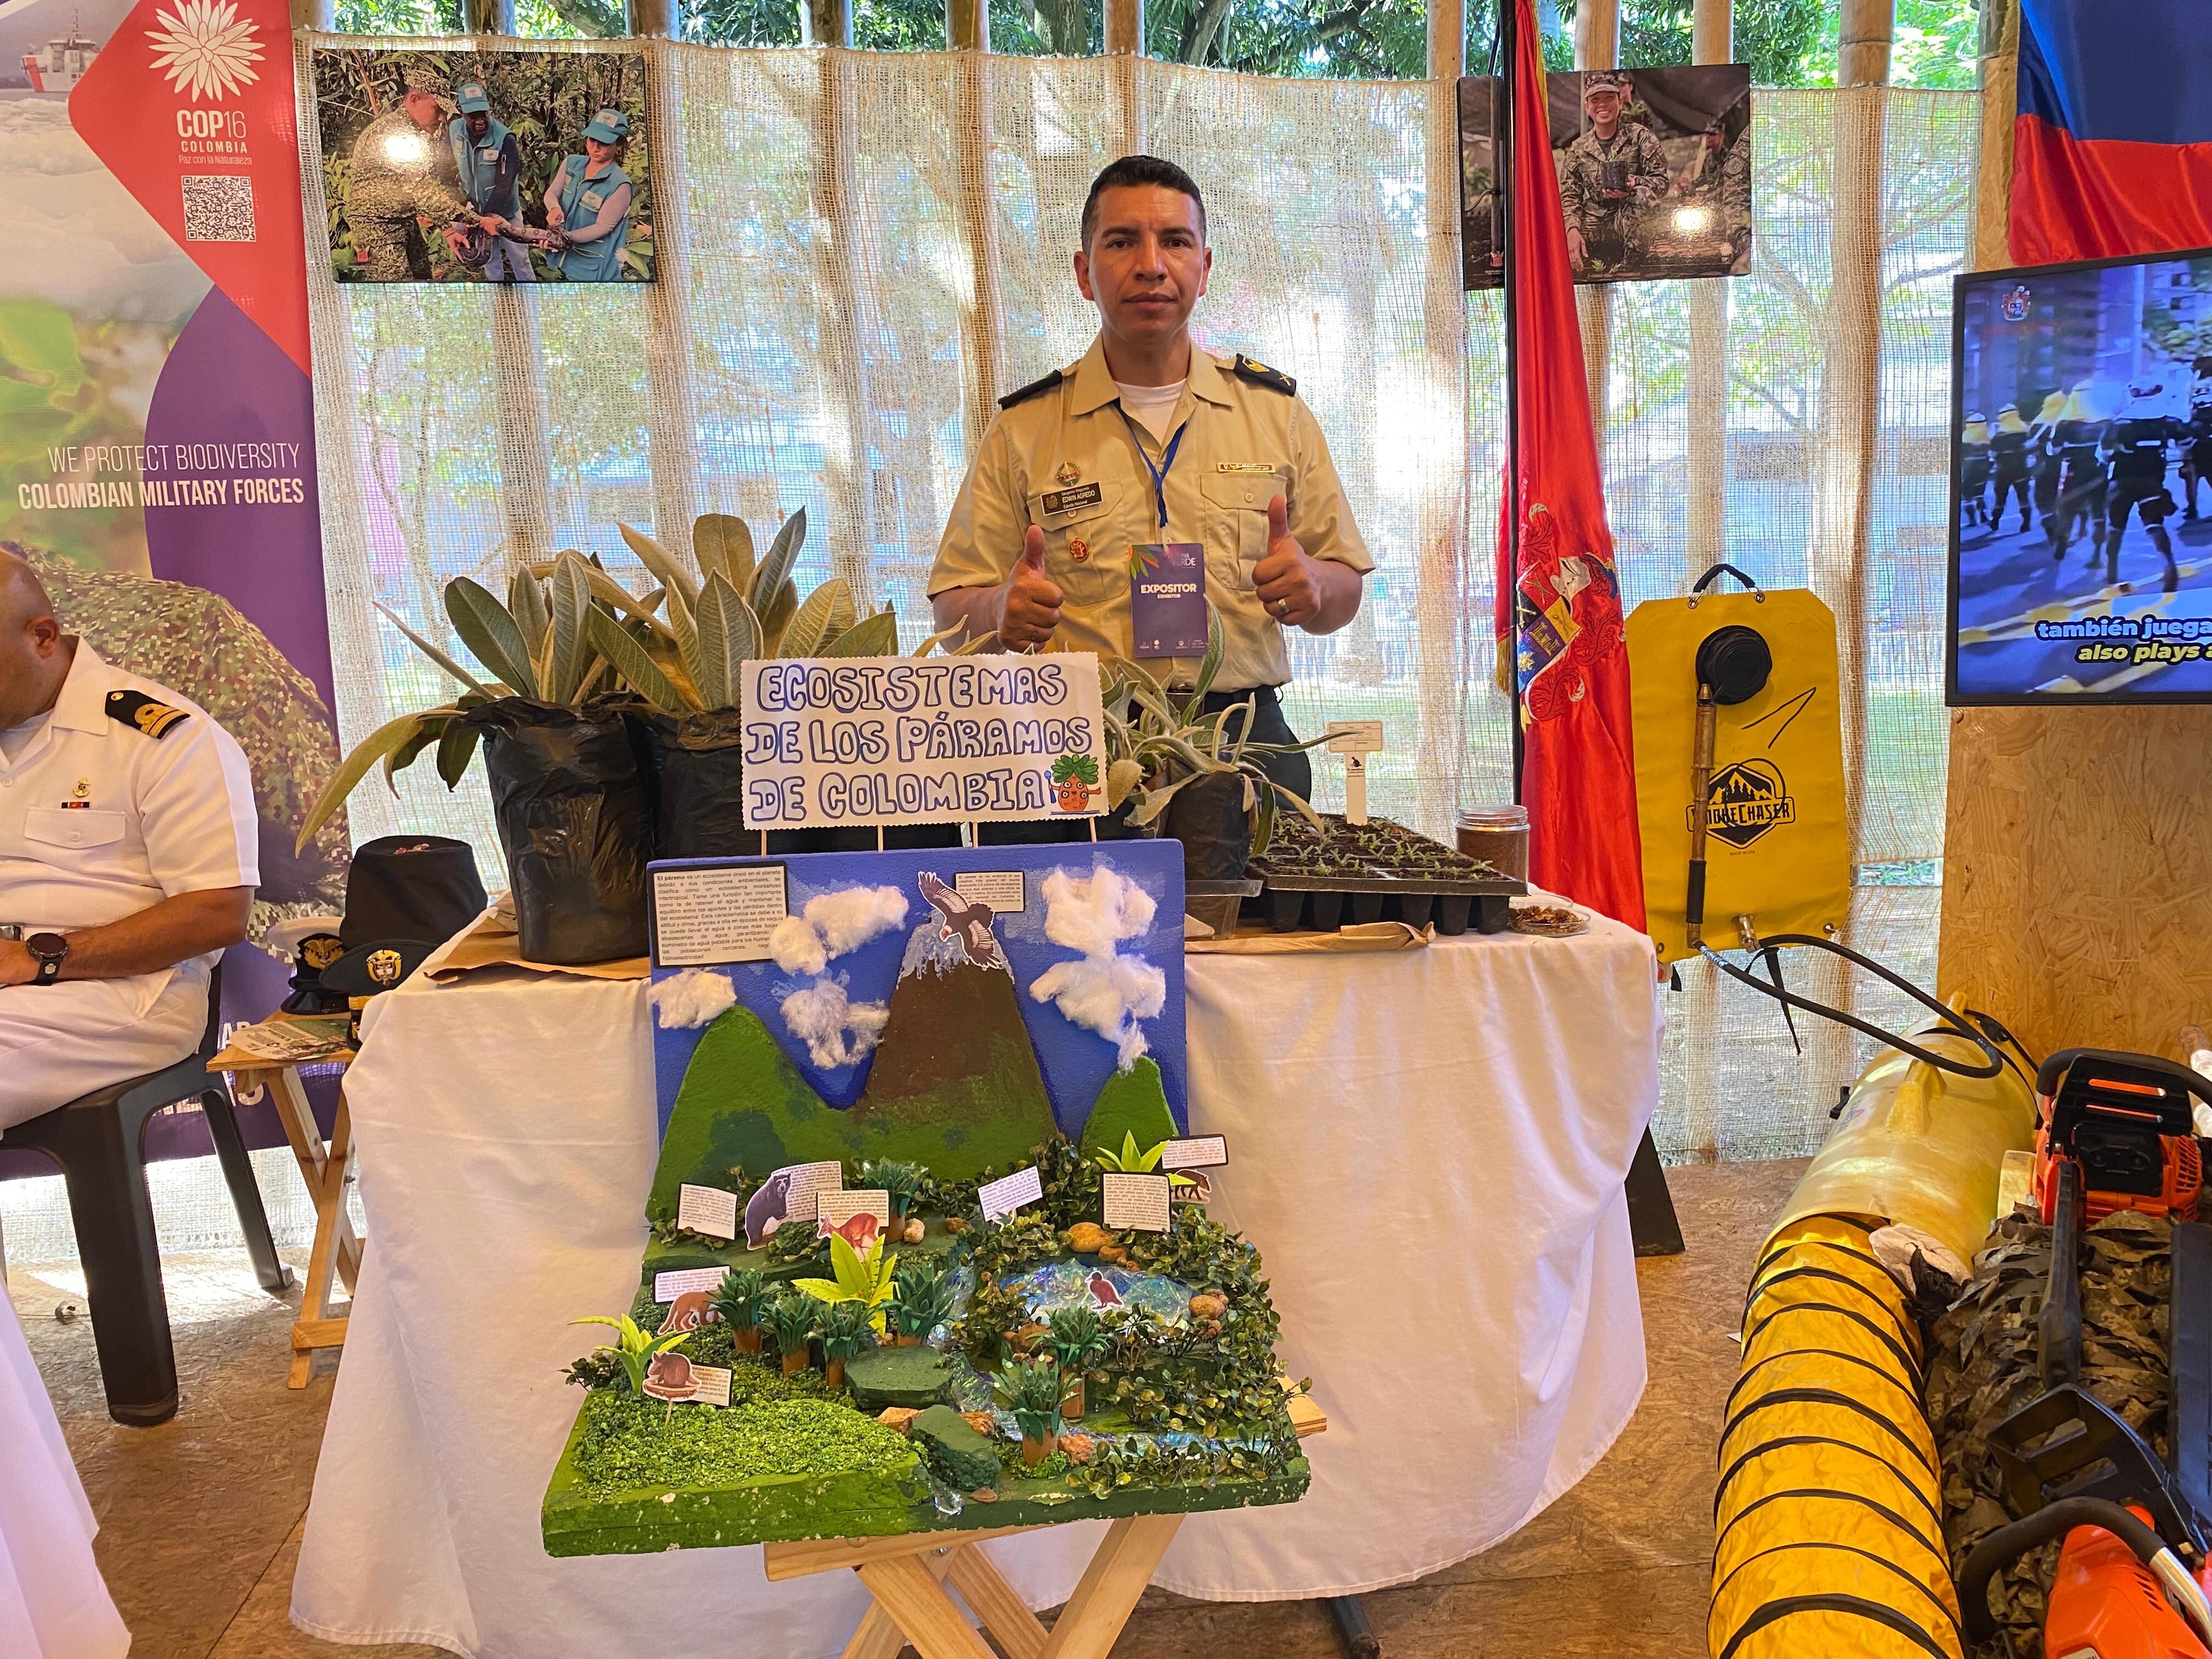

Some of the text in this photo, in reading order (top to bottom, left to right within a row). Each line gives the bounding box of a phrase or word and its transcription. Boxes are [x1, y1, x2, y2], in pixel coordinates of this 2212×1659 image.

[177, 110, 246, 138] COP16
[181, 140, 247, 154] COLOMBIA
[179, 155, 252, 165] Paz con la Naturaleza
[48, 443, 300, 472] WE PROTECT BIODIVERSITY
[18, 478, 304, 510] COLOMBIAN MILITARY FORCES
[1062, 490, 1095, 503] EDWIN AGREDO
[1141, 584, 1197, 594] EXPOSITOR
[2038, 619, 2138, 637] también
[2079, 645, 2129, 660] also
[2134, 643, 2200, 663] plays
[757, 664, 1068, 713] ECOSISTEMAS
[745, 711, 1092, 765] DE LOS PÁRAMOS
[749, 768, 1043, 822] DE COLOMBIA
